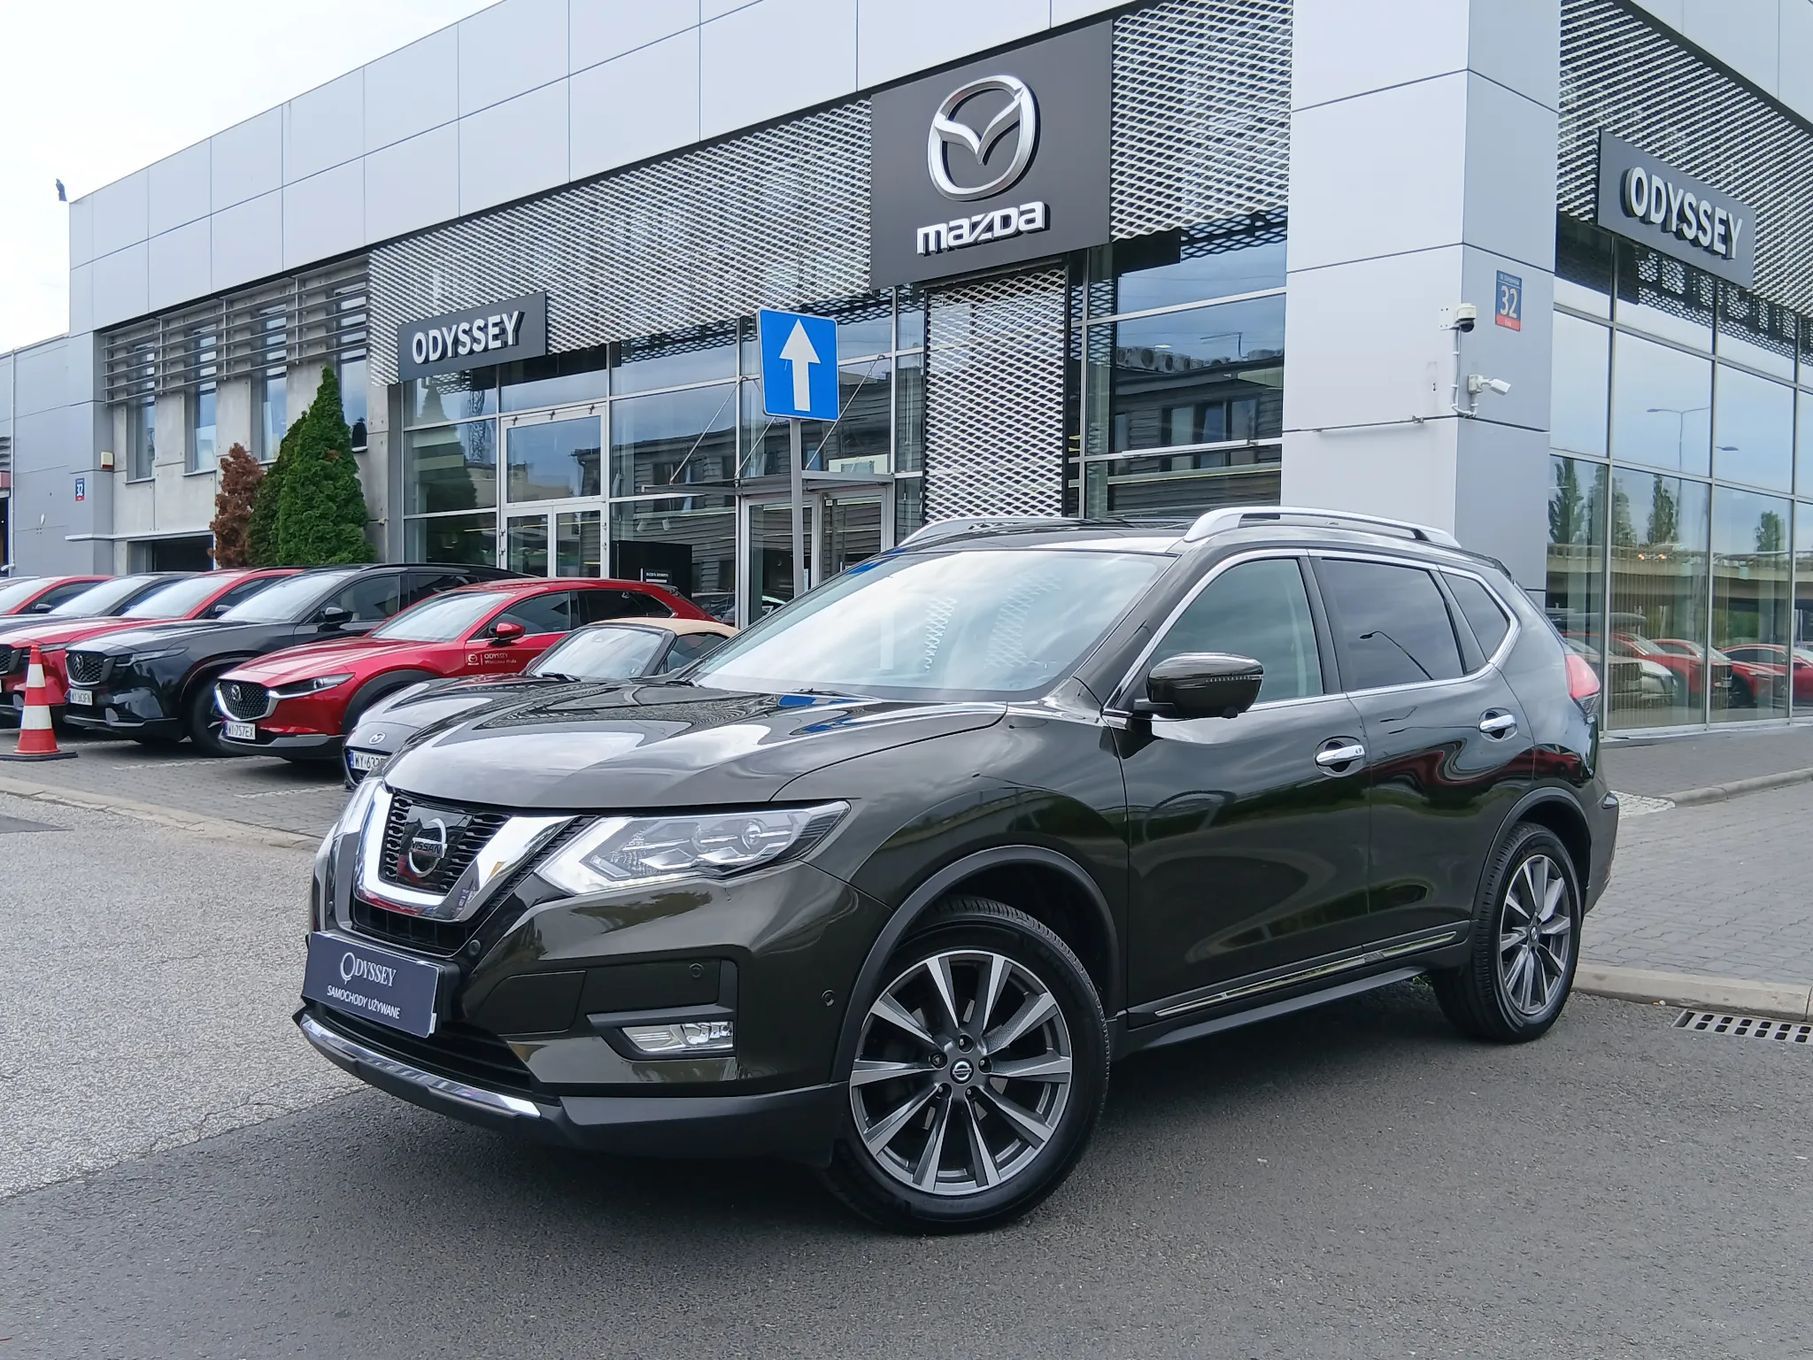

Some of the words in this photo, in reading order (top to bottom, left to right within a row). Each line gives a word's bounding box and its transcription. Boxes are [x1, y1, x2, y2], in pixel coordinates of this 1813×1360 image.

[916, 201, 1046, 255] mazda
[1627, 166, 1743, 259] ODYSSEY
[1501, 285, 1518, 318] 32
[412, 310, 522, 364] ODYSSEY
[340, 952, 397, 986] ODYSSEY
[327, 985, 367, 1008] SAMOCHODY
[368, 998, 401, 1019] UŻYWANE
